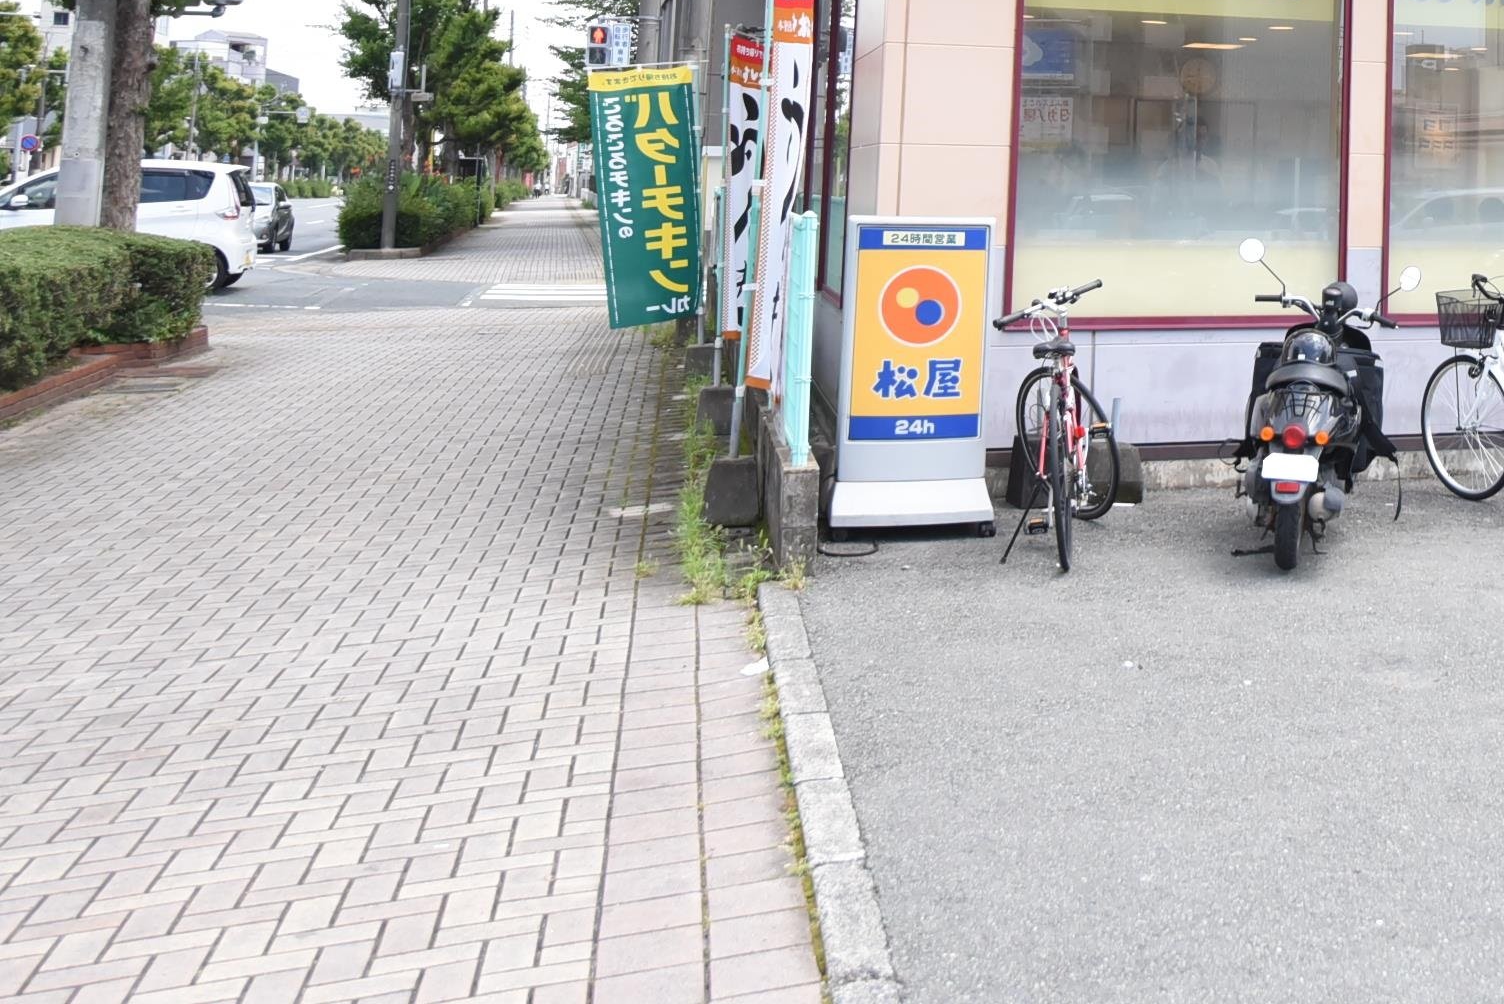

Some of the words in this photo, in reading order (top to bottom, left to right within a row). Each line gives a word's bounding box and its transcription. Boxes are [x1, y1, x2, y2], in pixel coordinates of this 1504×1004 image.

[890, 232, 957, 245] 24時間営業
[872, 359, 963, 399] 松屋
[895, 419, 935, 435] 24h
